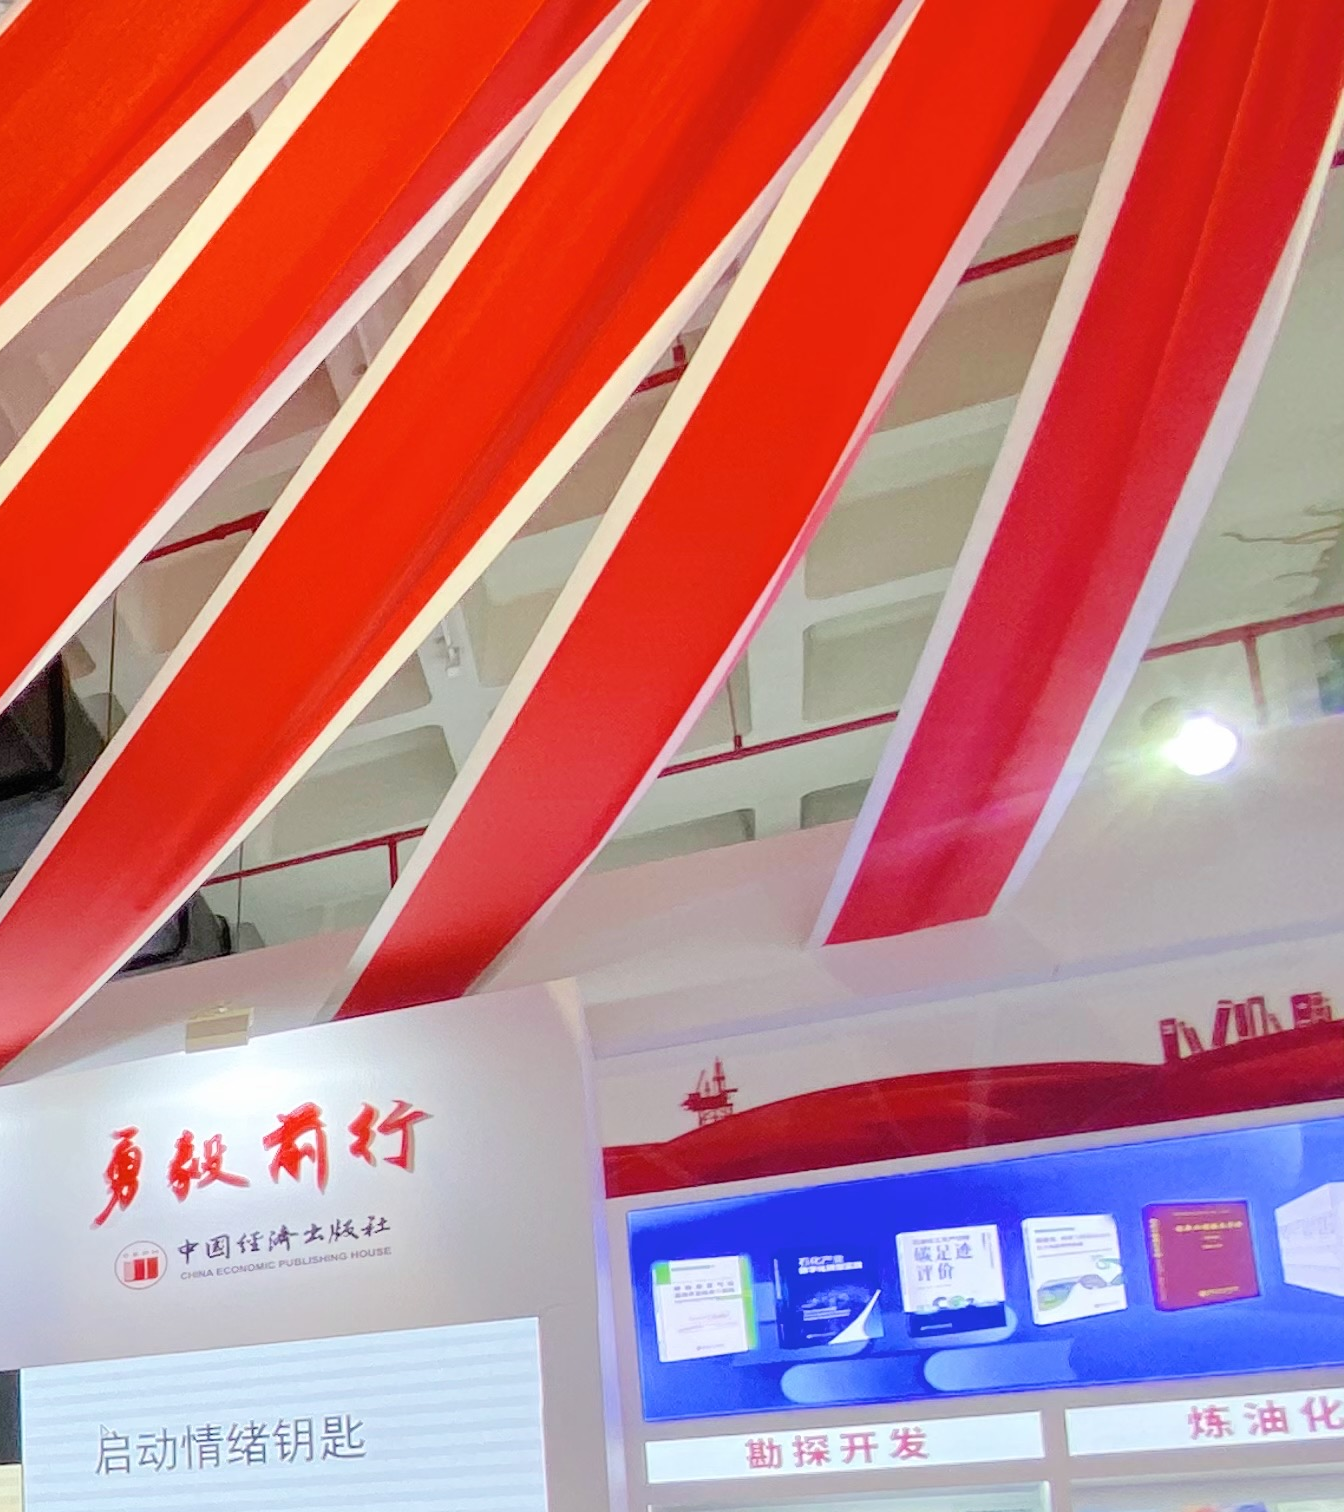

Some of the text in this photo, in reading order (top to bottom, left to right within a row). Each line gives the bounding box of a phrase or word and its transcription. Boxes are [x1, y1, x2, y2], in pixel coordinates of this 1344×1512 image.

[90, 1099, 434, 1229] 勇毅前行
[180, 1246, 393, 1281] CHINA ECONOMIC PUBLISHING HOUSE
[95, 1414, 368, 1475] 启动情绪钥匙
[745, 1426, 930, 1471] 勘探开发
